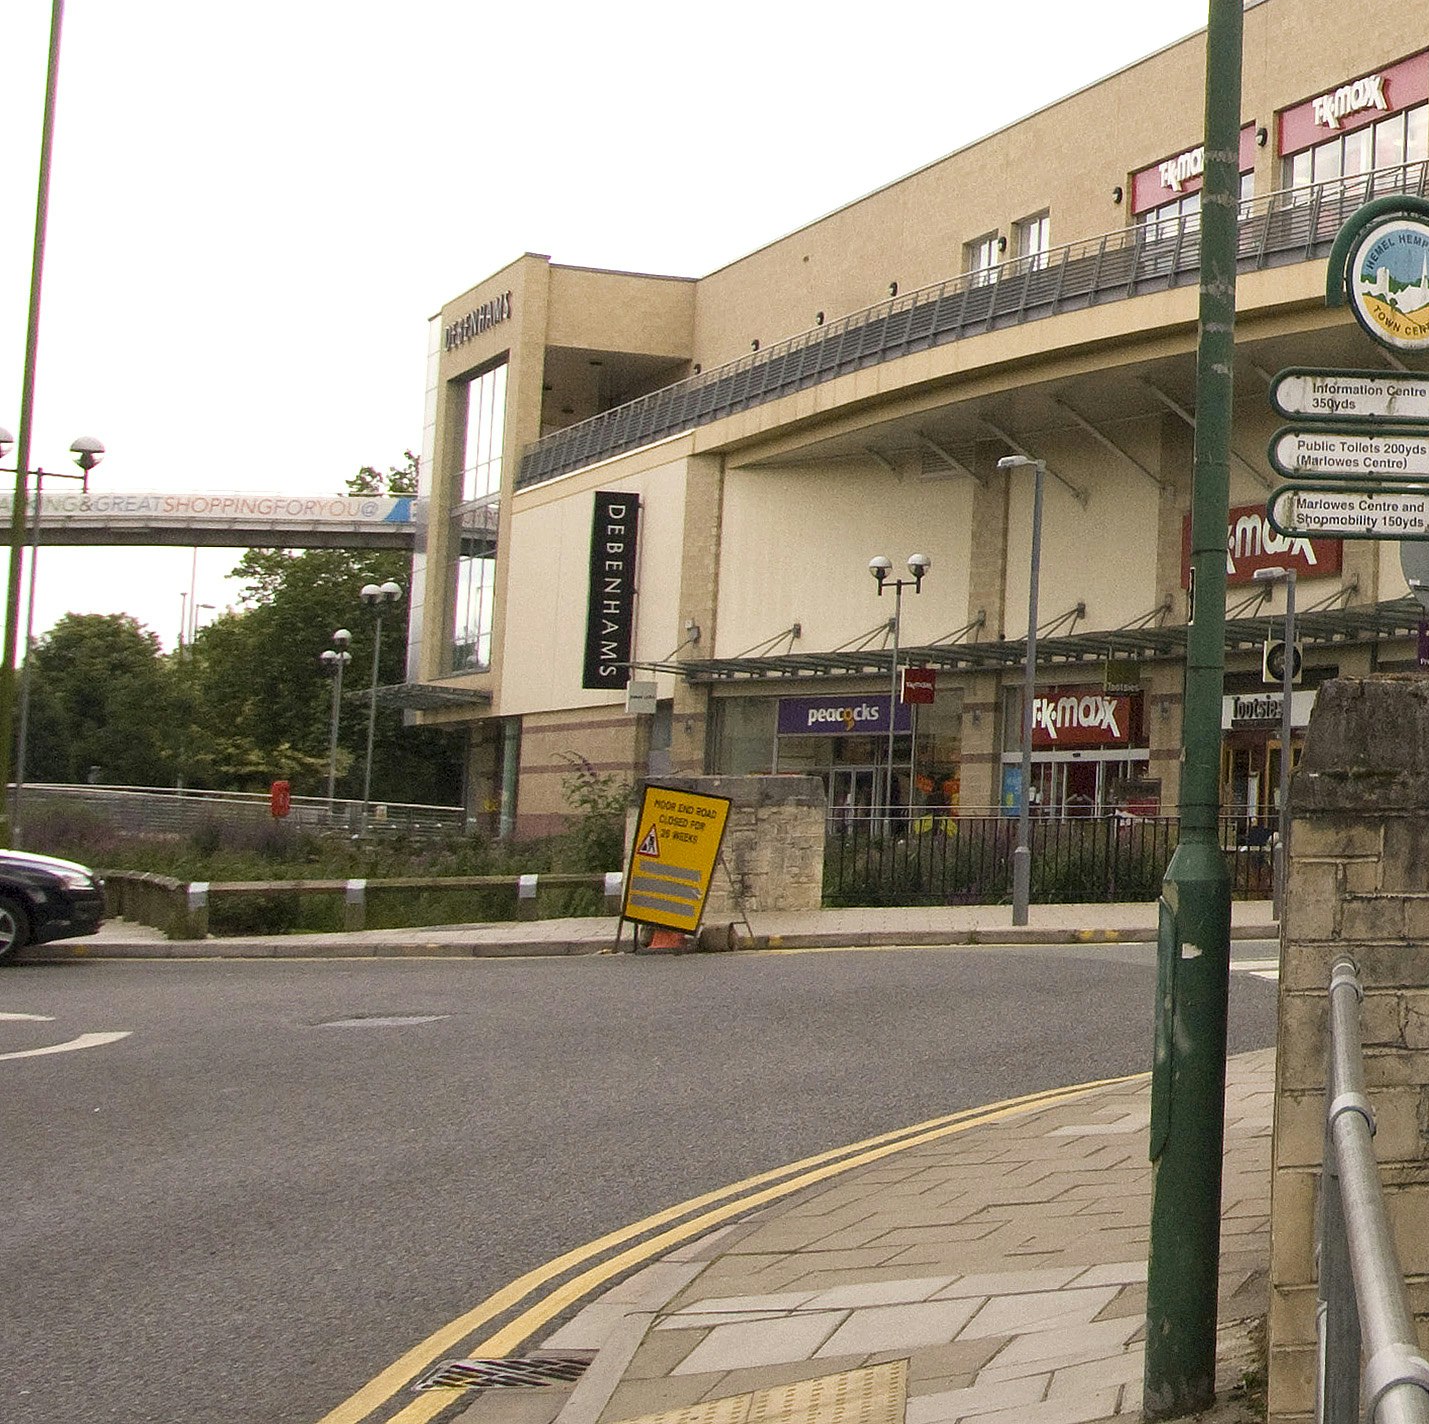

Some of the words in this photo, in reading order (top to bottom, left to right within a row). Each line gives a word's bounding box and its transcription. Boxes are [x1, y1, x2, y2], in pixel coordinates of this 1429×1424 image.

[1366, 238, 1395, 270] HEMEL
[445, 290, 512, 352] DEBENHAMS
[1373, 305, 1401, 333] TOWN
[1312, 383, 1383, 396] Information
[1386, 385, 1427, 397] Centre
[1312, 399, 1356, 410] 350yds
[1298, 440, 1336, 452] Public
[1340, 442, 1380, 454] Toilets
[1384, 444, 1427, 456] 200yds
[1297, 455, 1359, 467] (Marlowes
[1363, 457, 1408, 469] Centre)
[1296, 498, 1355, 510] Marlowes
[1359, 500, 1399, 512] Centre
[1402, 502, 1425, 513] and
[1296, 514, 1378, 528] Shopmobility
[1382, 516, 1424, 528] 150yds
[600, 504, 626, 677] DEBENHAMS
[807, 703, 879, 731] peacocks
